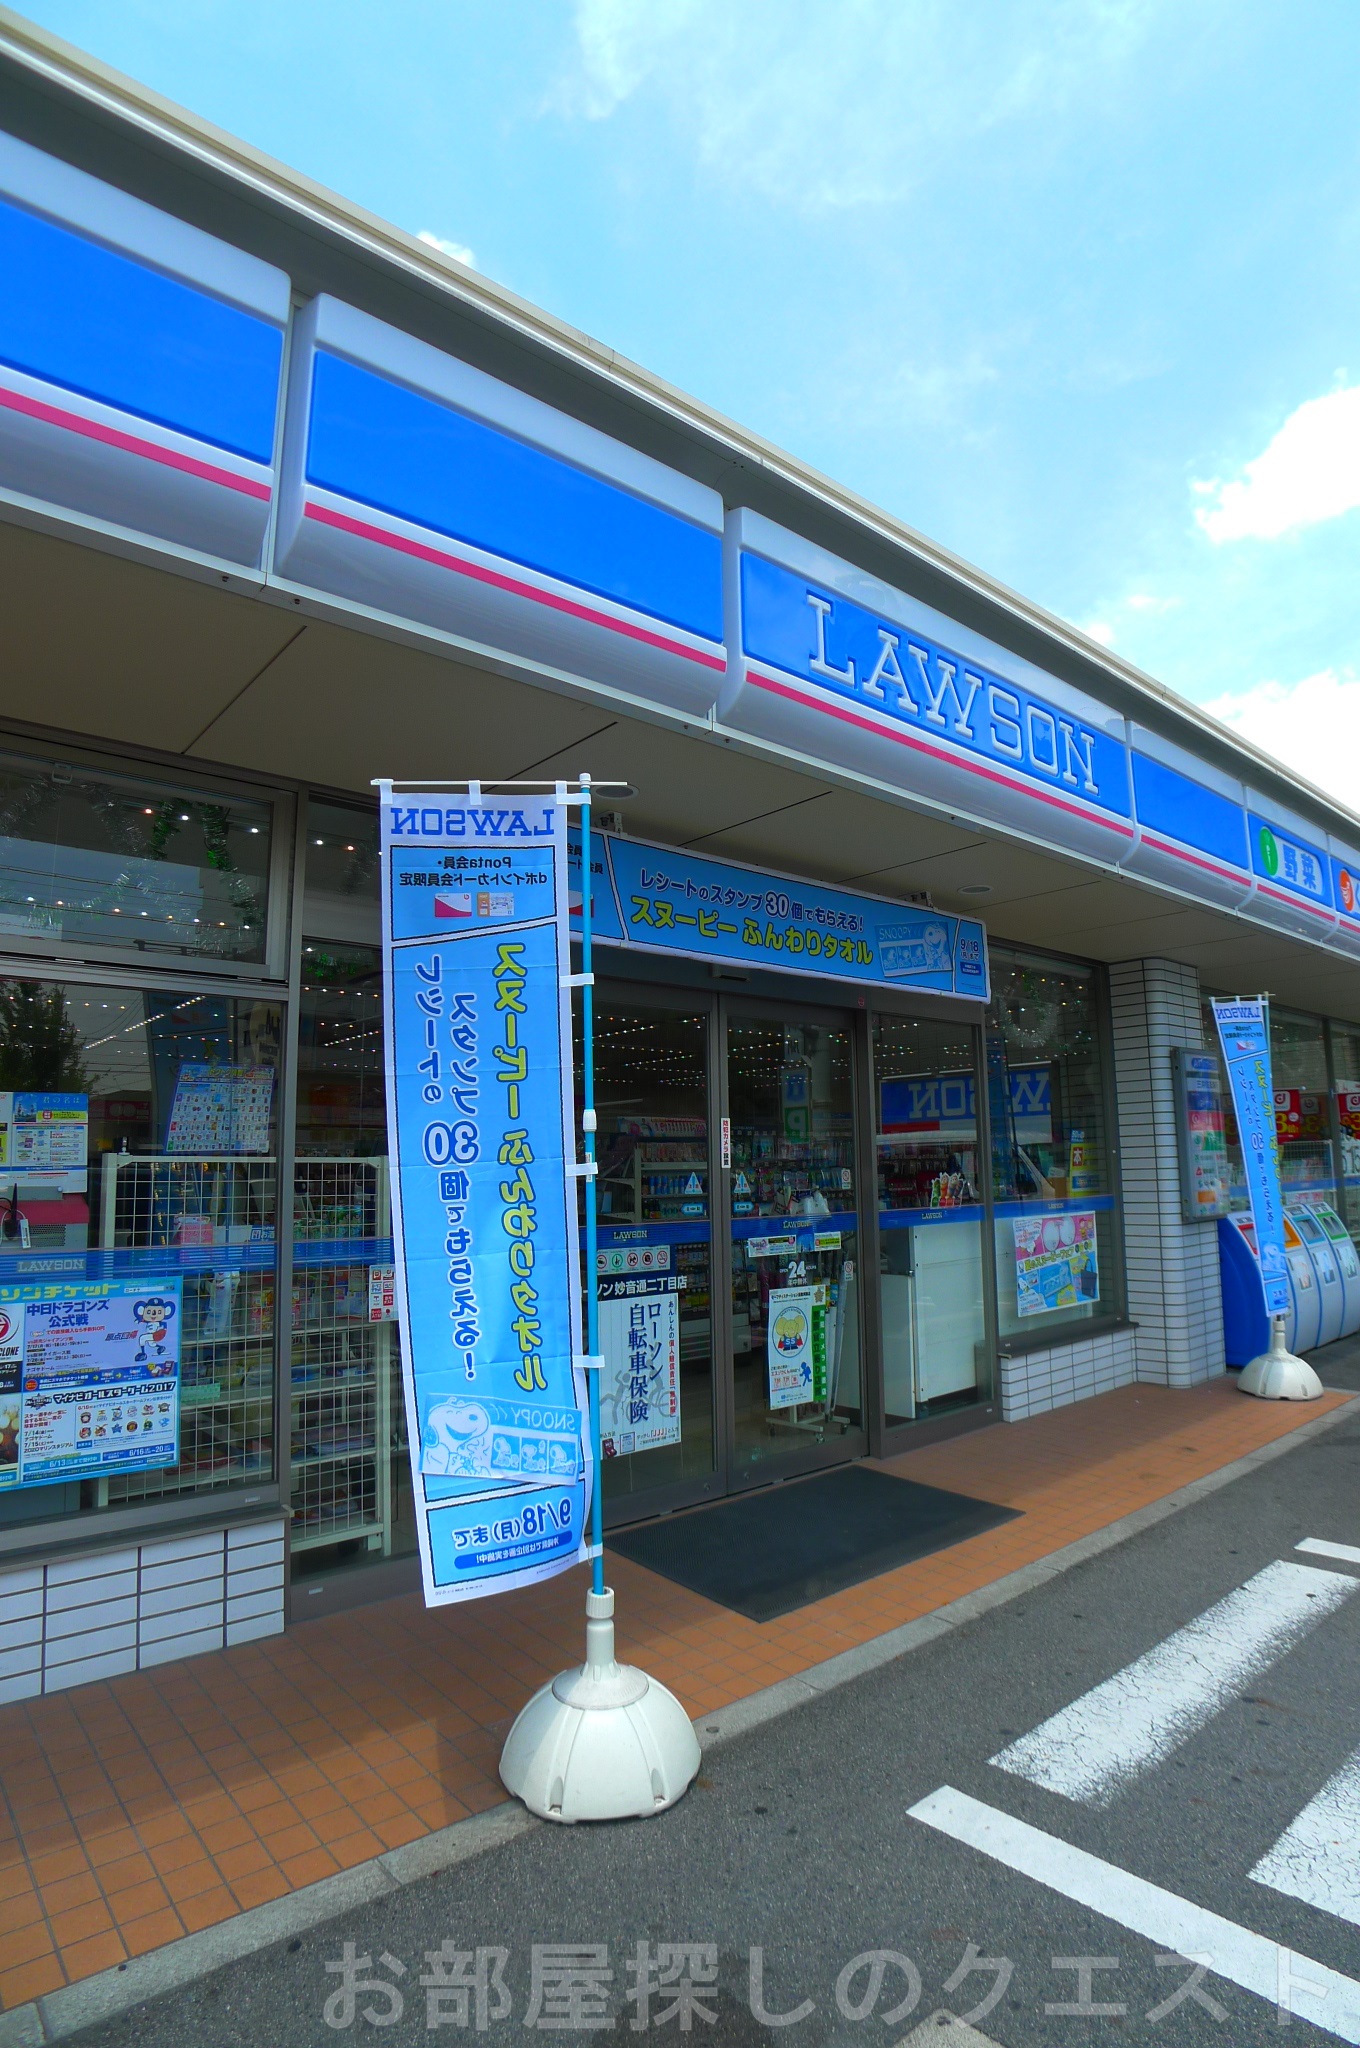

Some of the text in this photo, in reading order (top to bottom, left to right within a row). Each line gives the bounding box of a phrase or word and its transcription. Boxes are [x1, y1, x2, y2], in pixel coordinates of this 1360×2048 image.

[807, 593, 1099, 795] LAWSON
[1283, 843, 1317, 891] 野菜
[640, 868, 865, 933] レシートのスタンプ30個でもらえる!
[630, 896, 874, 966] スヌーピー ふんわりタオル
[960, 938, 979, 952] 9/18
[613, 1230, 648, 1240] LAWSON
[17, 1259, 85, 1273] LAWSON
[789, 1260, 806, 1279] 24
[0, 1284, 120, 1301] ソンチケット
[27, 1299, 111, 1317] 中日ドラゴンズ
[49, 1314, 89, 1329] 公式戦
[648, 1302, 664, 1381] ローソン
[785, 1337, 796, 1345] SS
[628, 1303, 649, 1425] 自転車保険
[53, 1382, 177, 1403] マイナビオールスターゲーム2017
